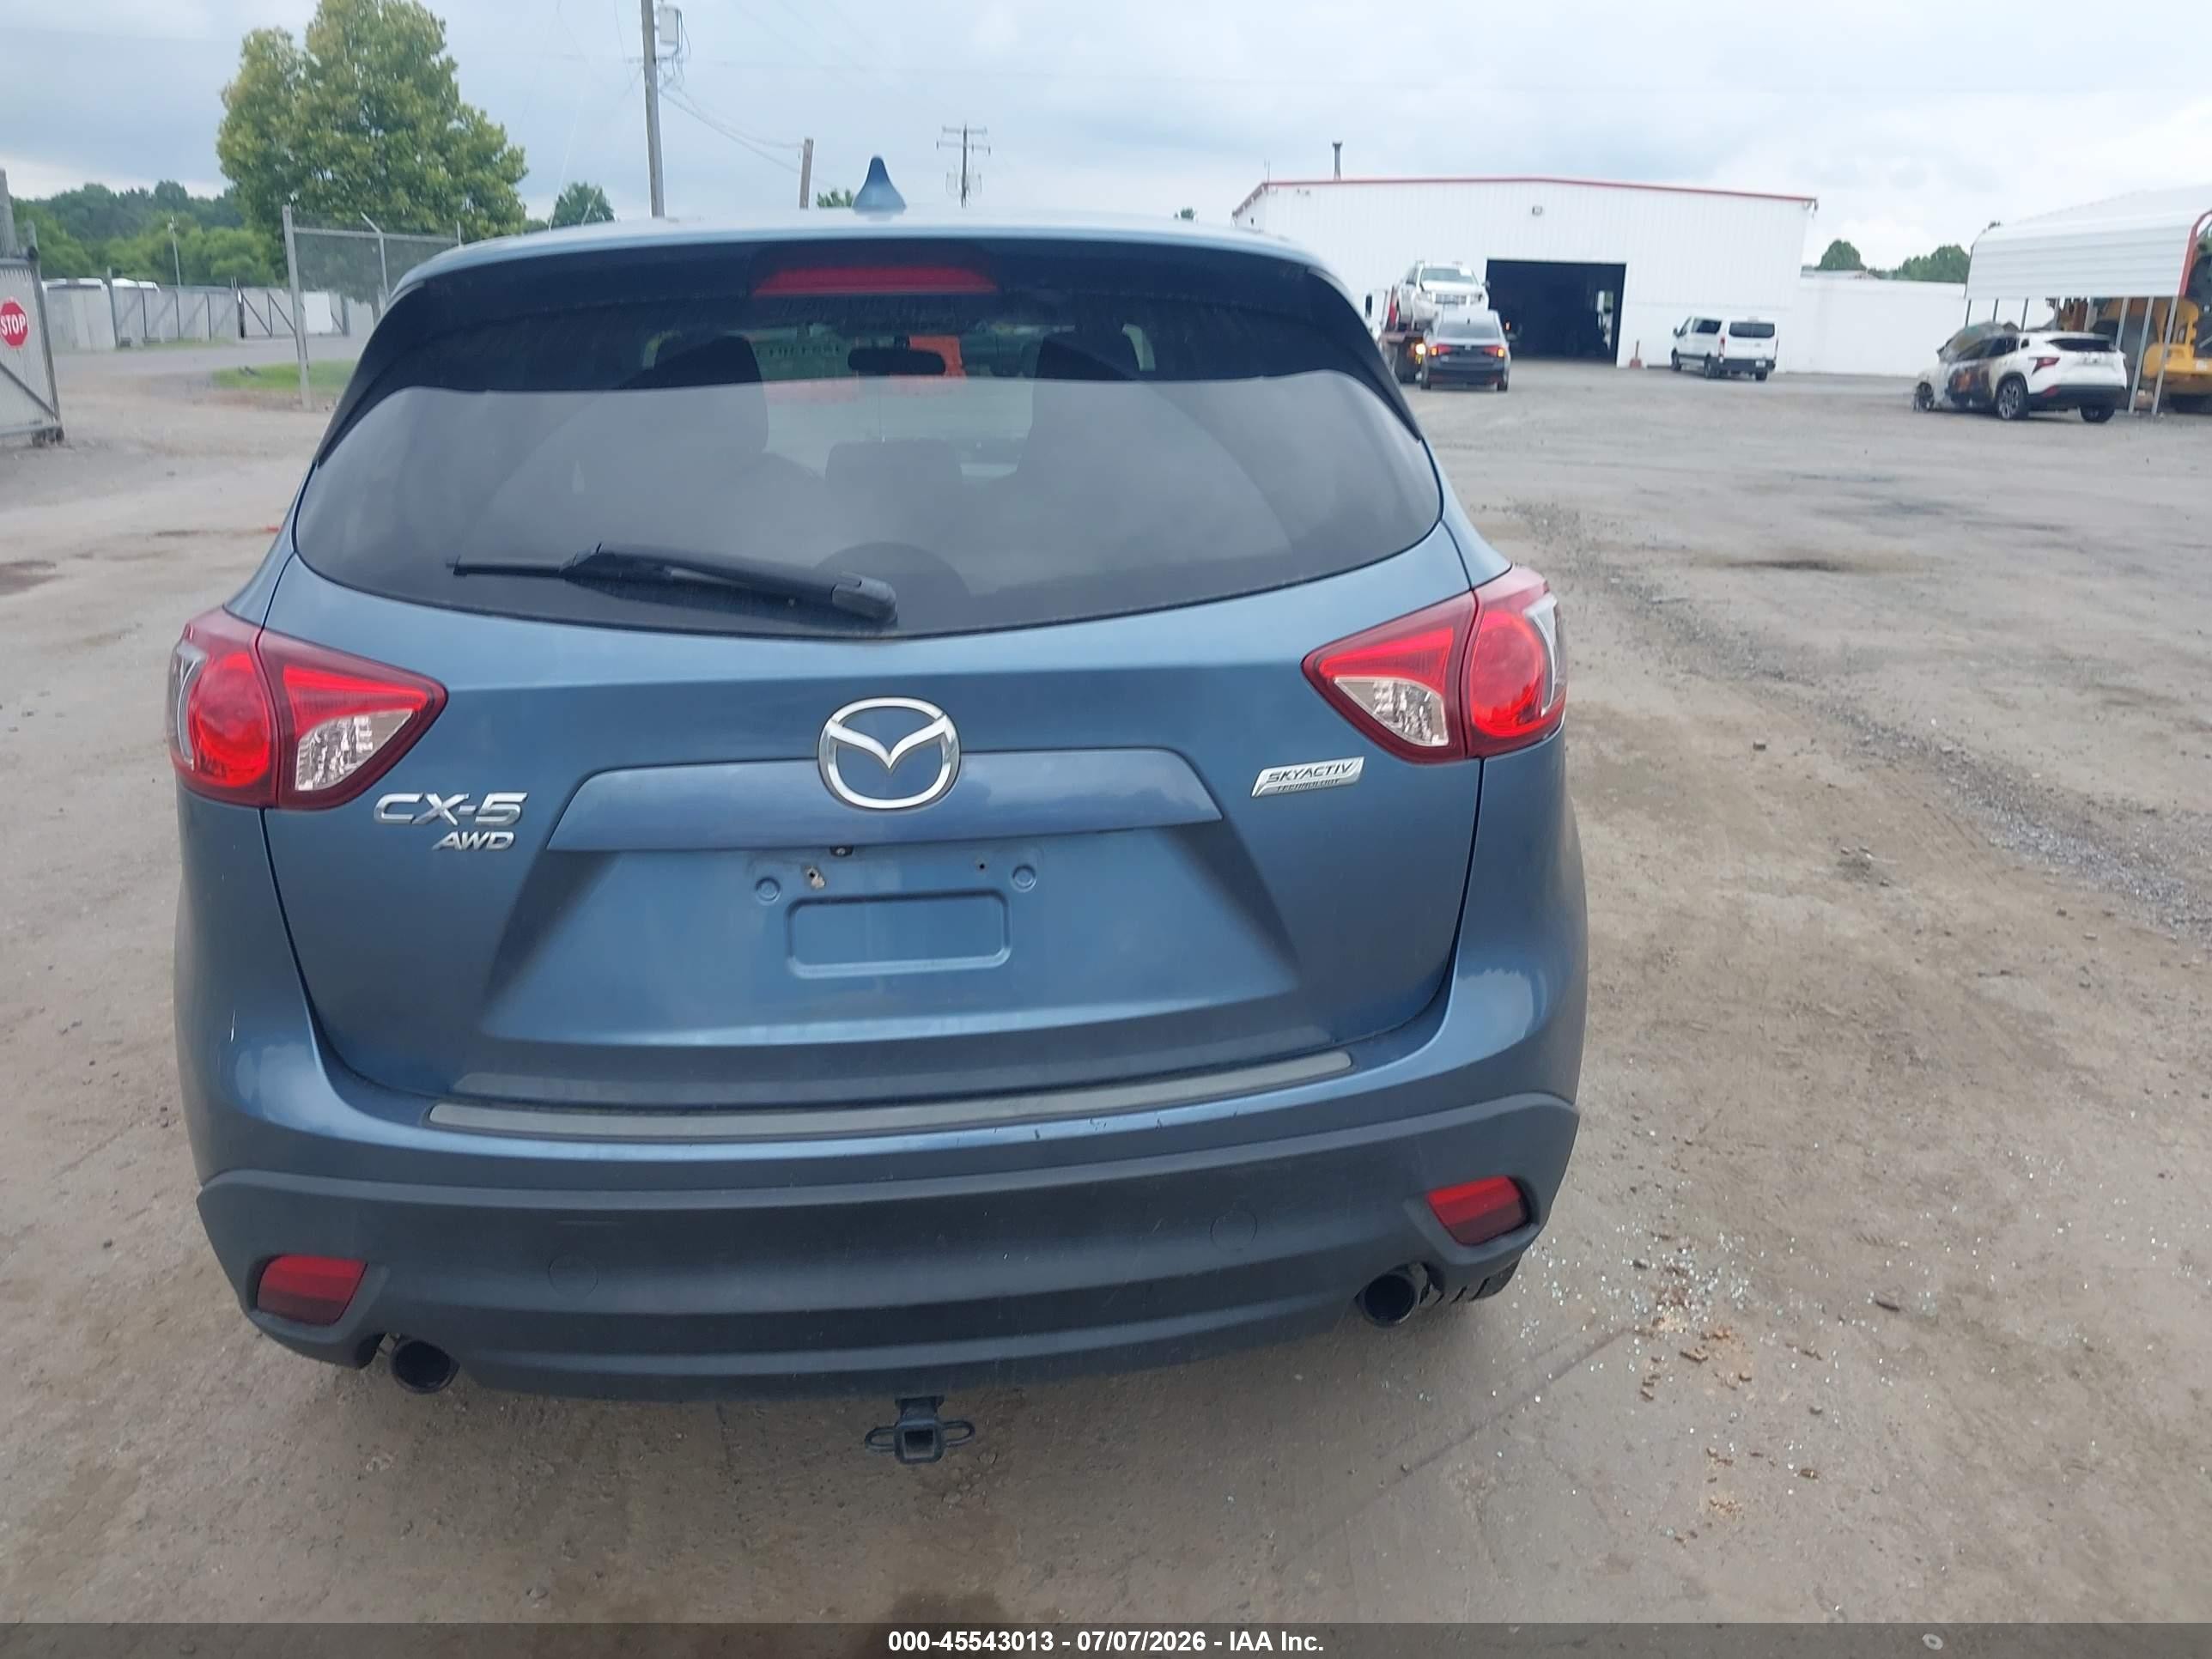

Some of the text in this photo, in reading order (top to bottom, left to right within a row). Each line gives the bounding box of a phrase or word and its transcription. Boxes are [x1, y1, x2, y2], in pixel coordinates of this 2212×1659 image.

[1, 313, 26, 336] STOP
[1266, 762, 1353, 783] SKYACTIV
[373, 792, 528, 826] CX-5
[431, 830, 516, 851] AWD
